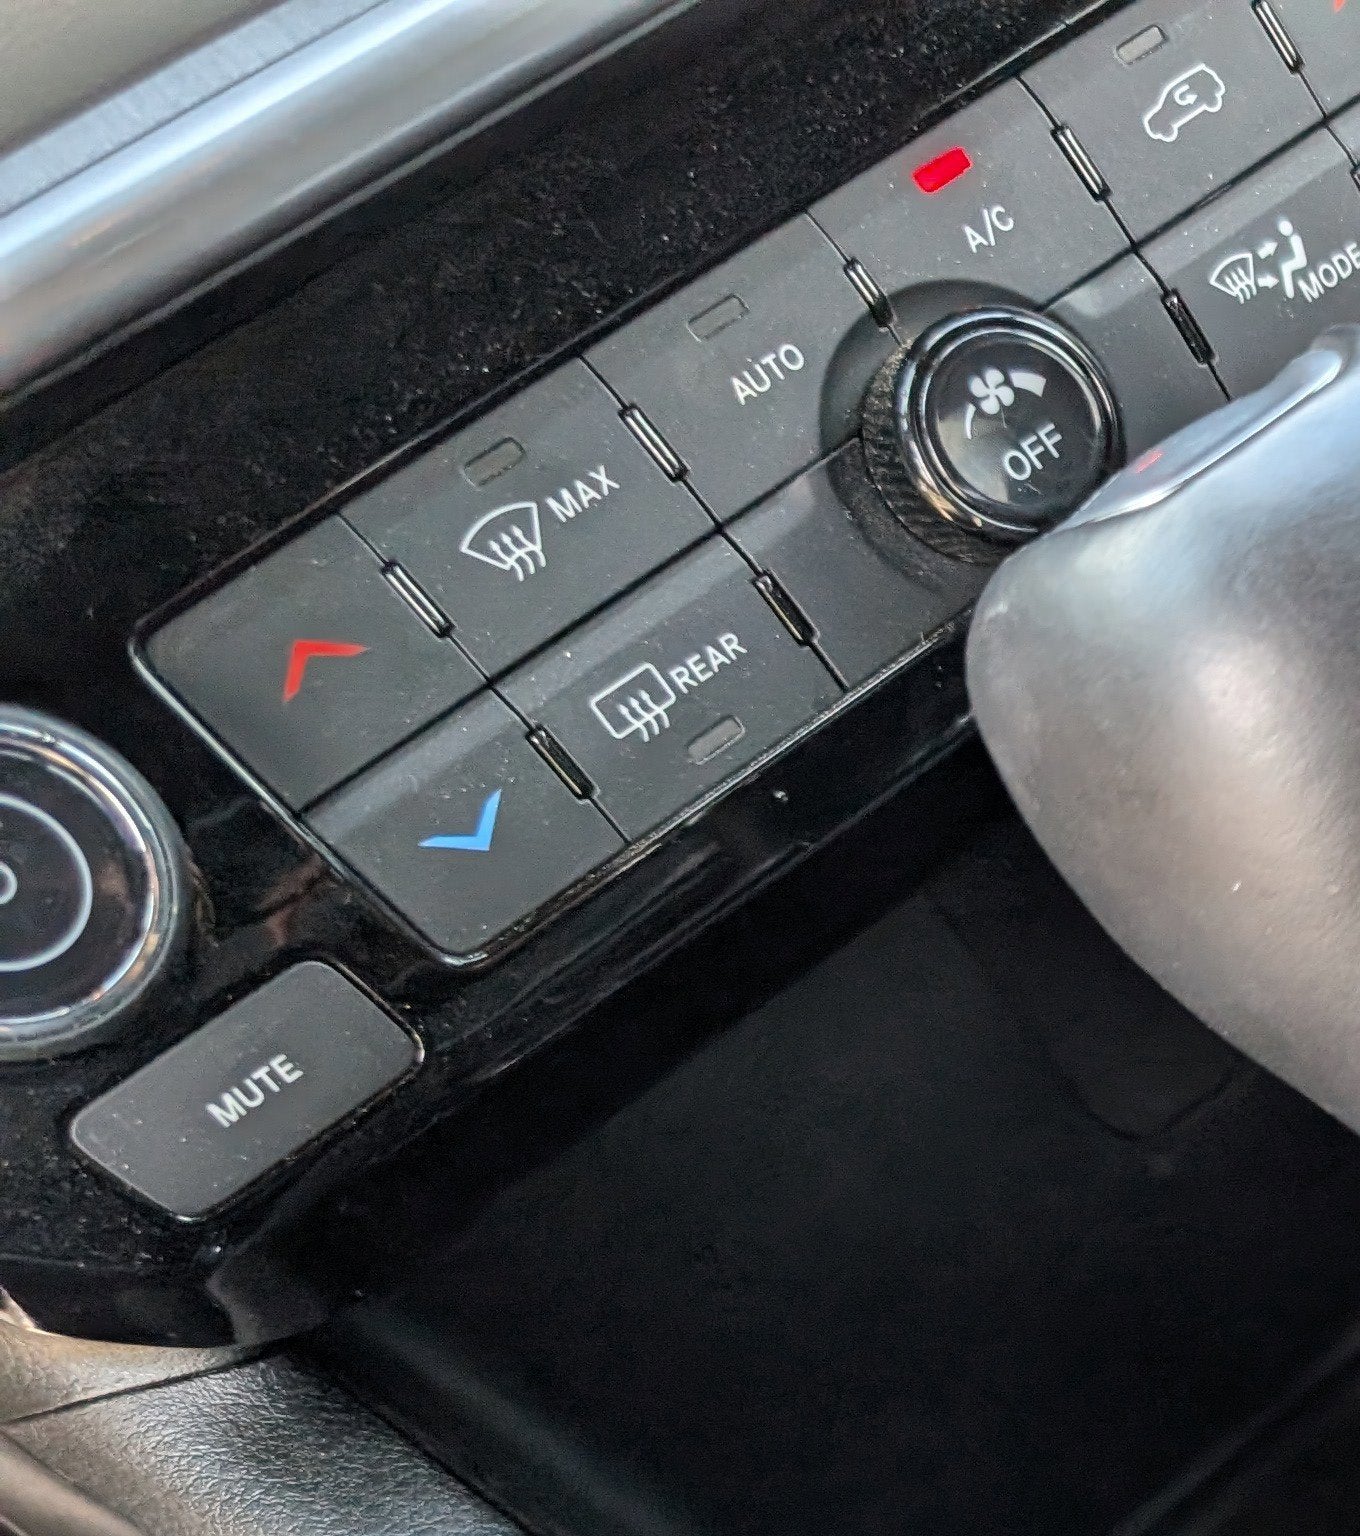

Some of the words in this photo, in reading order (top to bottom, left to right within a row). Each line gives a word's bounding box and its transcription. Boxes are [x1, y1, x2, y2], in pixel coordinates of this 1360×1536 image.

[962, 204, 1015, 255] A/C
[730, 342, 805, 405] AUTO
[1003, 420, 1062, 484] OFF
[549, 466, 621, 524] MAX
[669, 631, 749, 695] REAR
[204, 1053, 303, 1128] MUTE
